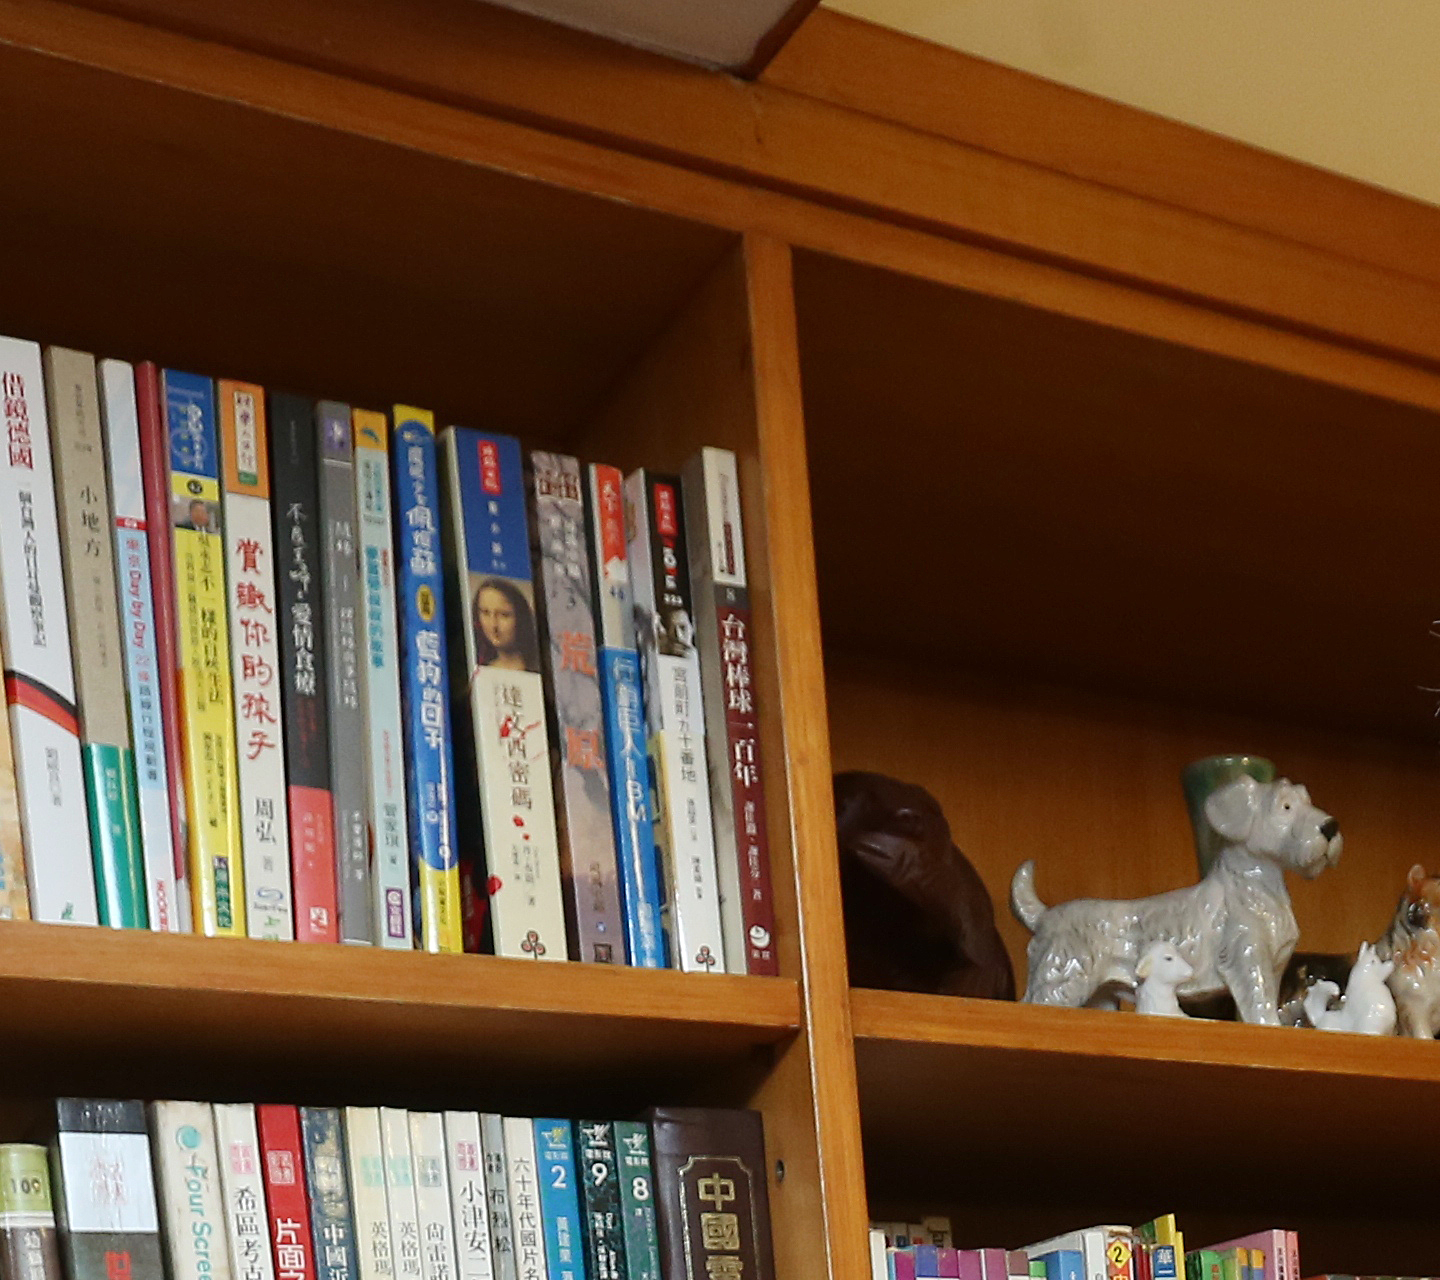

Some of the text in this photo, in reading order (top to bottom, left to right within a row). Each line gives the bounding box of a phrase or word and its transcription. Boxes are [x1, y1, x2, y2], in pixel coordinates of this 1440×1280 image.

[233, 537, 278, 760] 賞識你的孩子
[550, 1164, 568, 1190] 2
[591, 1162, 608, 1187] 9
[186, 1163, 206, 1217] Four
[631, 1176, 650, 1201] 8
[1112, 1245, 1125, 1265] 2
